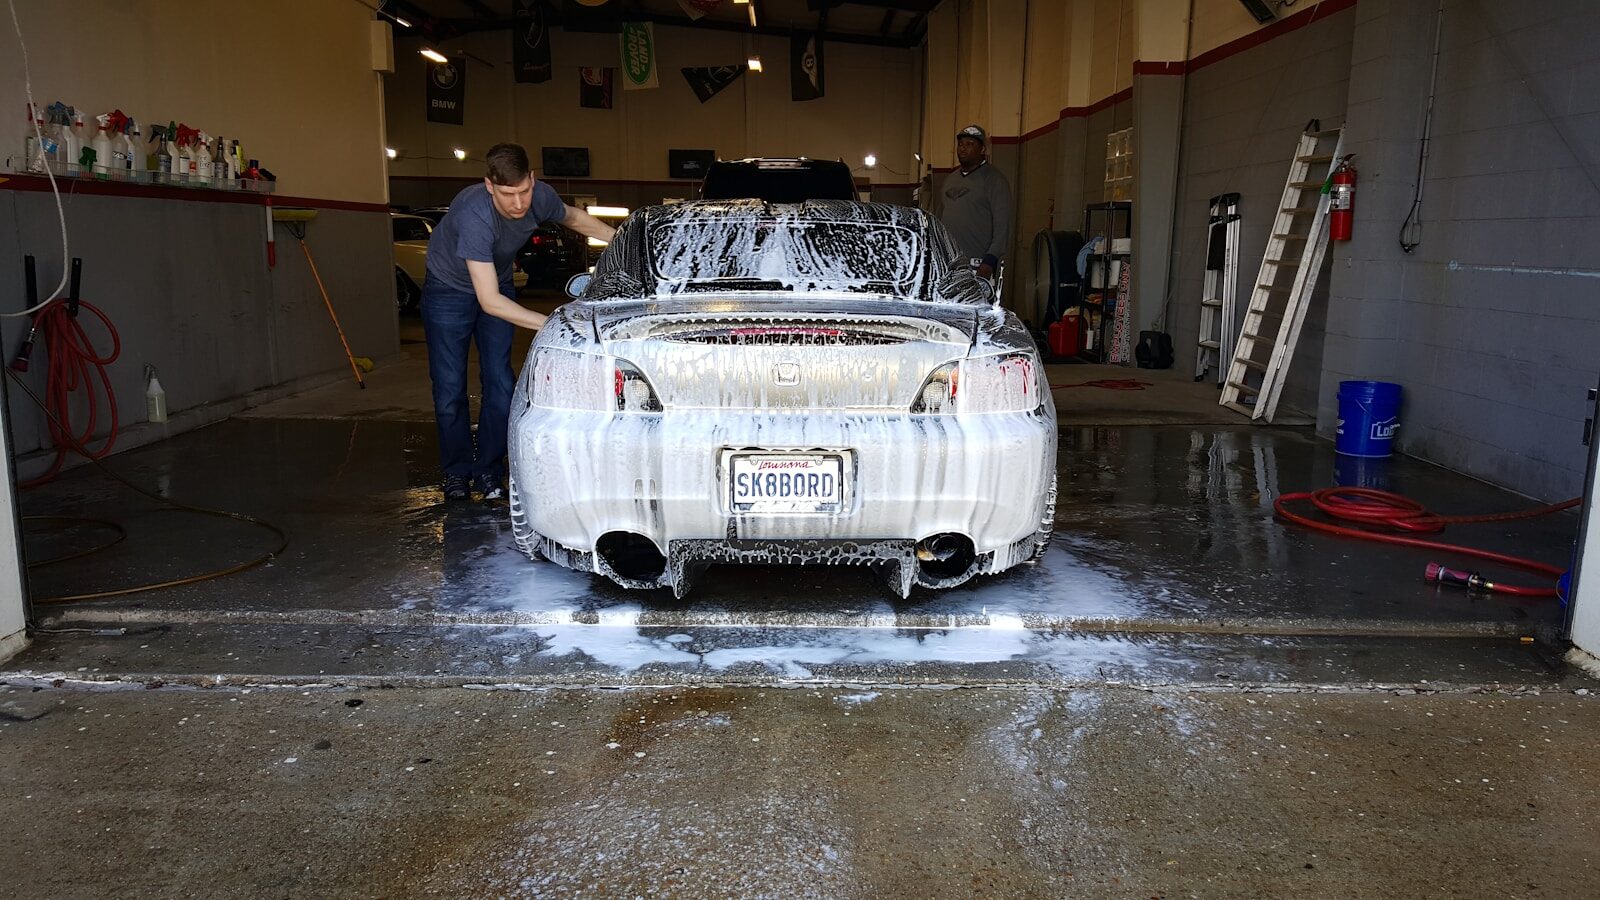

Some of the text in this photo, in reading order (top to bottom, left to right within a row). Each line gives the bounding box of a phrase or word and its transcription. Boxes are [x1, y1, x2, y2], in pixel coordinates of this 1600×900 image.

[628, 33, 640, 76] ROVER
[637, 30, 649, 64] LAND
[431, 98, 457, 110] BMW
[1110, 292, 1126, 363] EMPLOYEES
[1119, 261, 1130, 291] ONLY
[737, 473, 834, 497] SK8BORD
